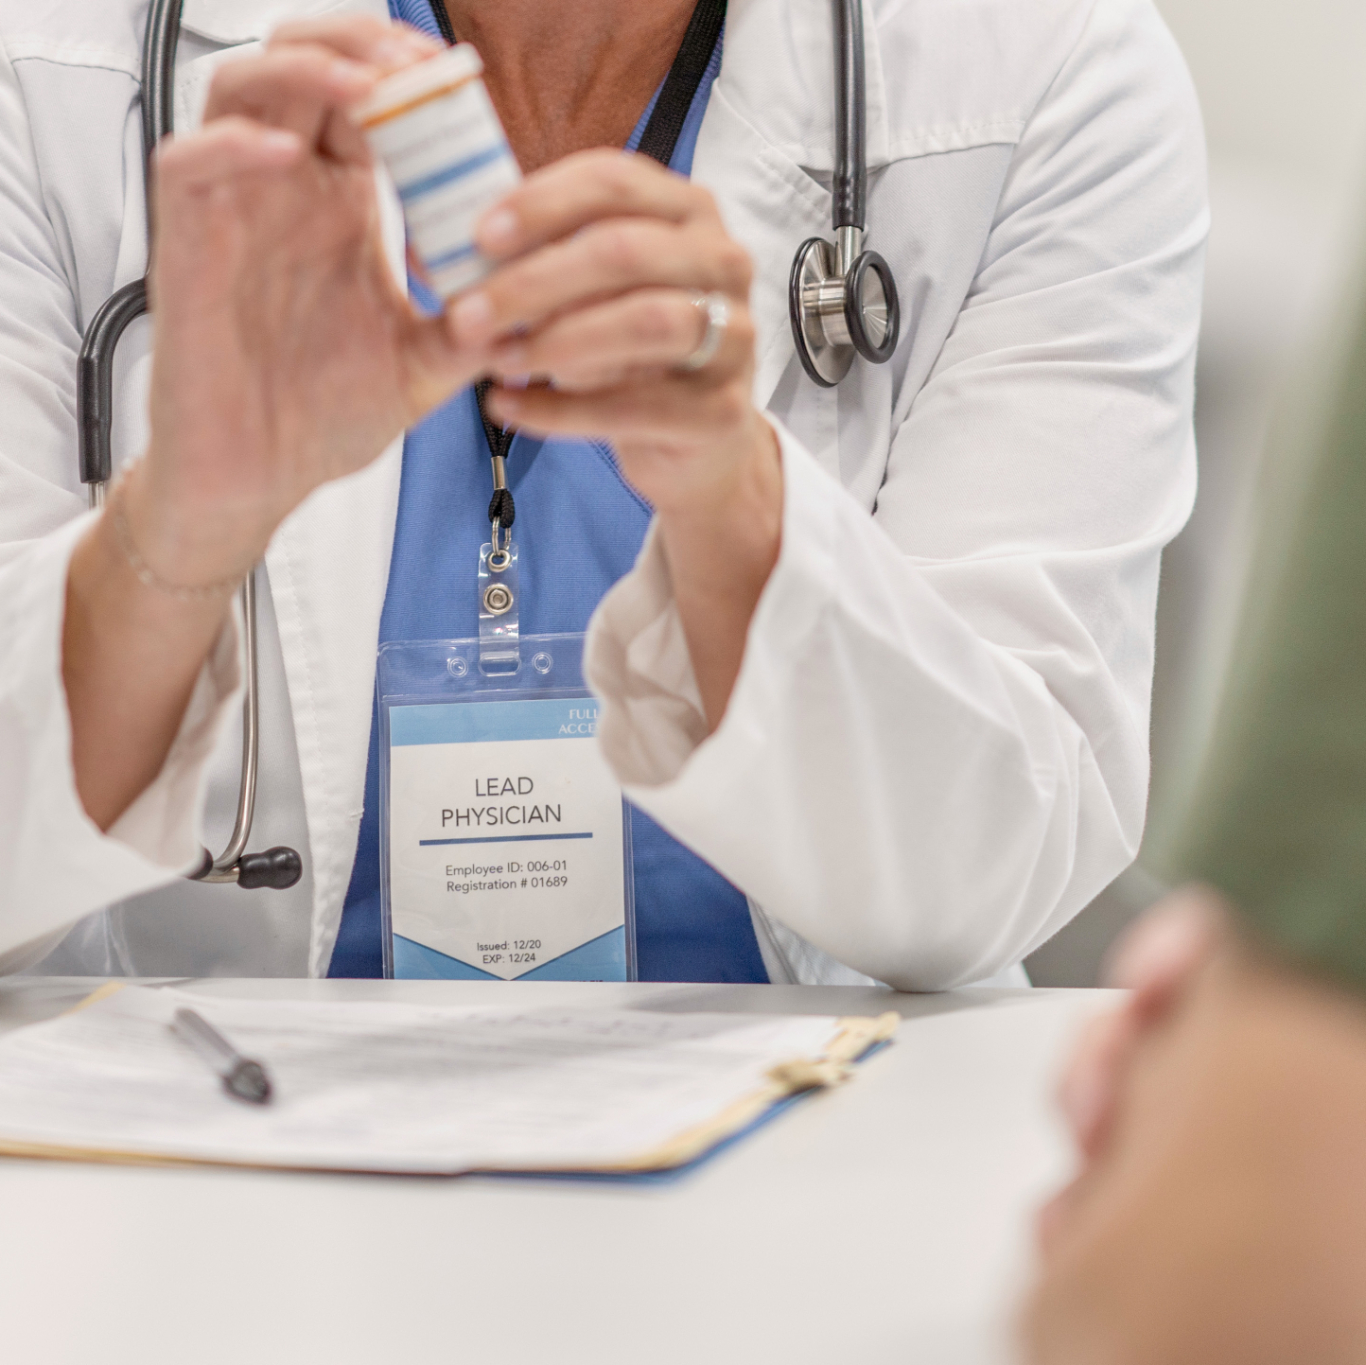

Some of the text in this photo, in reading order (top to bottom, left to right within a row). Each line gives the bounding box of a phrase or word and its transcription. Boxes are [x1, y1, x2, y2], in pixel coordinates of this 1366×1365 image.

[569, 708, 599, 720] FULL
[558, 723, 597, 734] ACCE
[475, 776, 534, 797] LEAD
[441, 804, 561, 827] PHYSICIAN
[445, 860, 567, 878] Employee ID: 006-01
[446, 876, 568, 894] Registration # 01689
[477, 939, 542, 951] Issued: 12/20
[482, 952, 536, 964] EXP: 12/24
